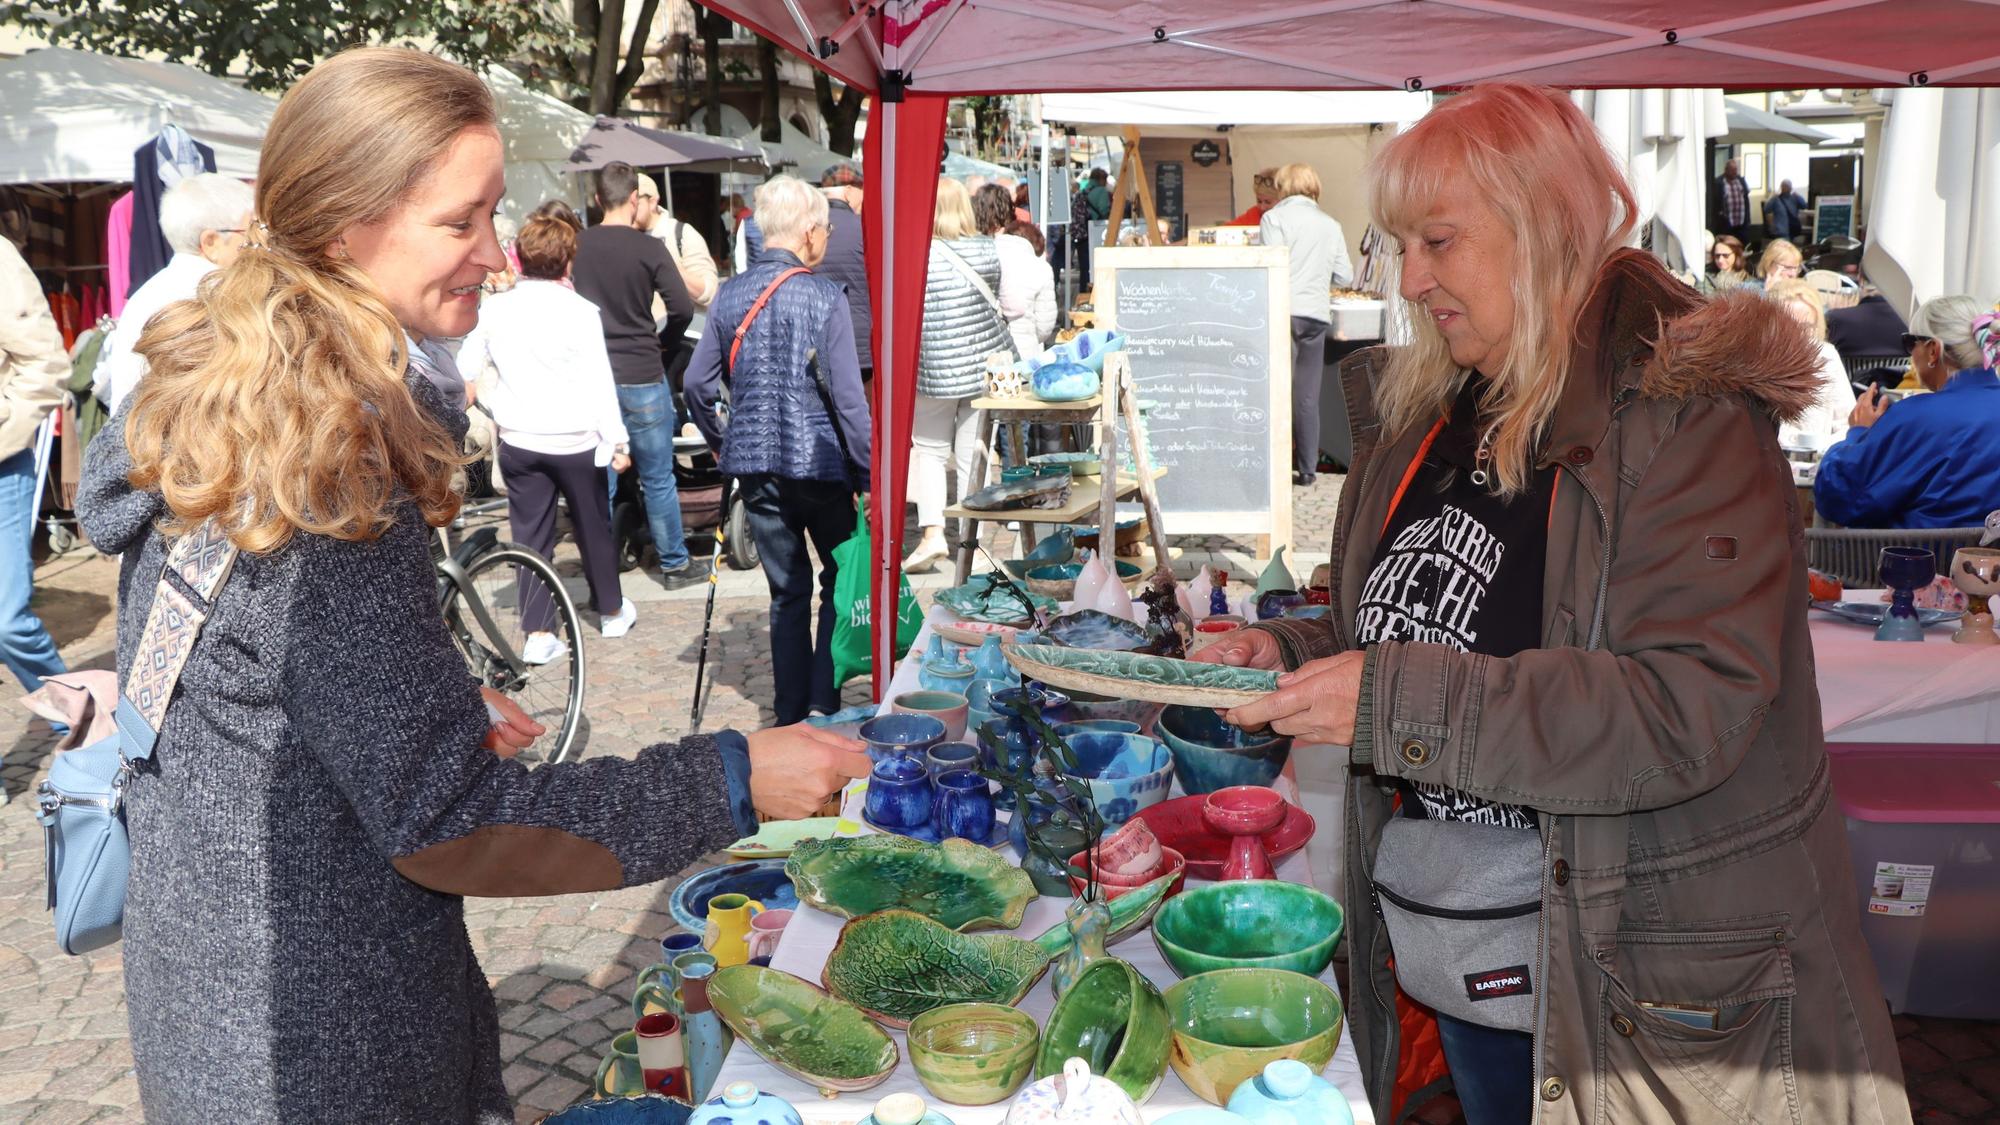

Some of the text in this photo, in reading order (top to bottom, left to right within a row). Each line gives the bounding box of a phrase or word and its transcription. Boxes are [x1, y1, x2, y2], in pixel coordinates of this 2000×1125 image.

[1442, 508, 1505, 584] GIRLS
[1358, 551, 1434, 614] ARE
[1475, 976, 1522, 991] EASTPAK
